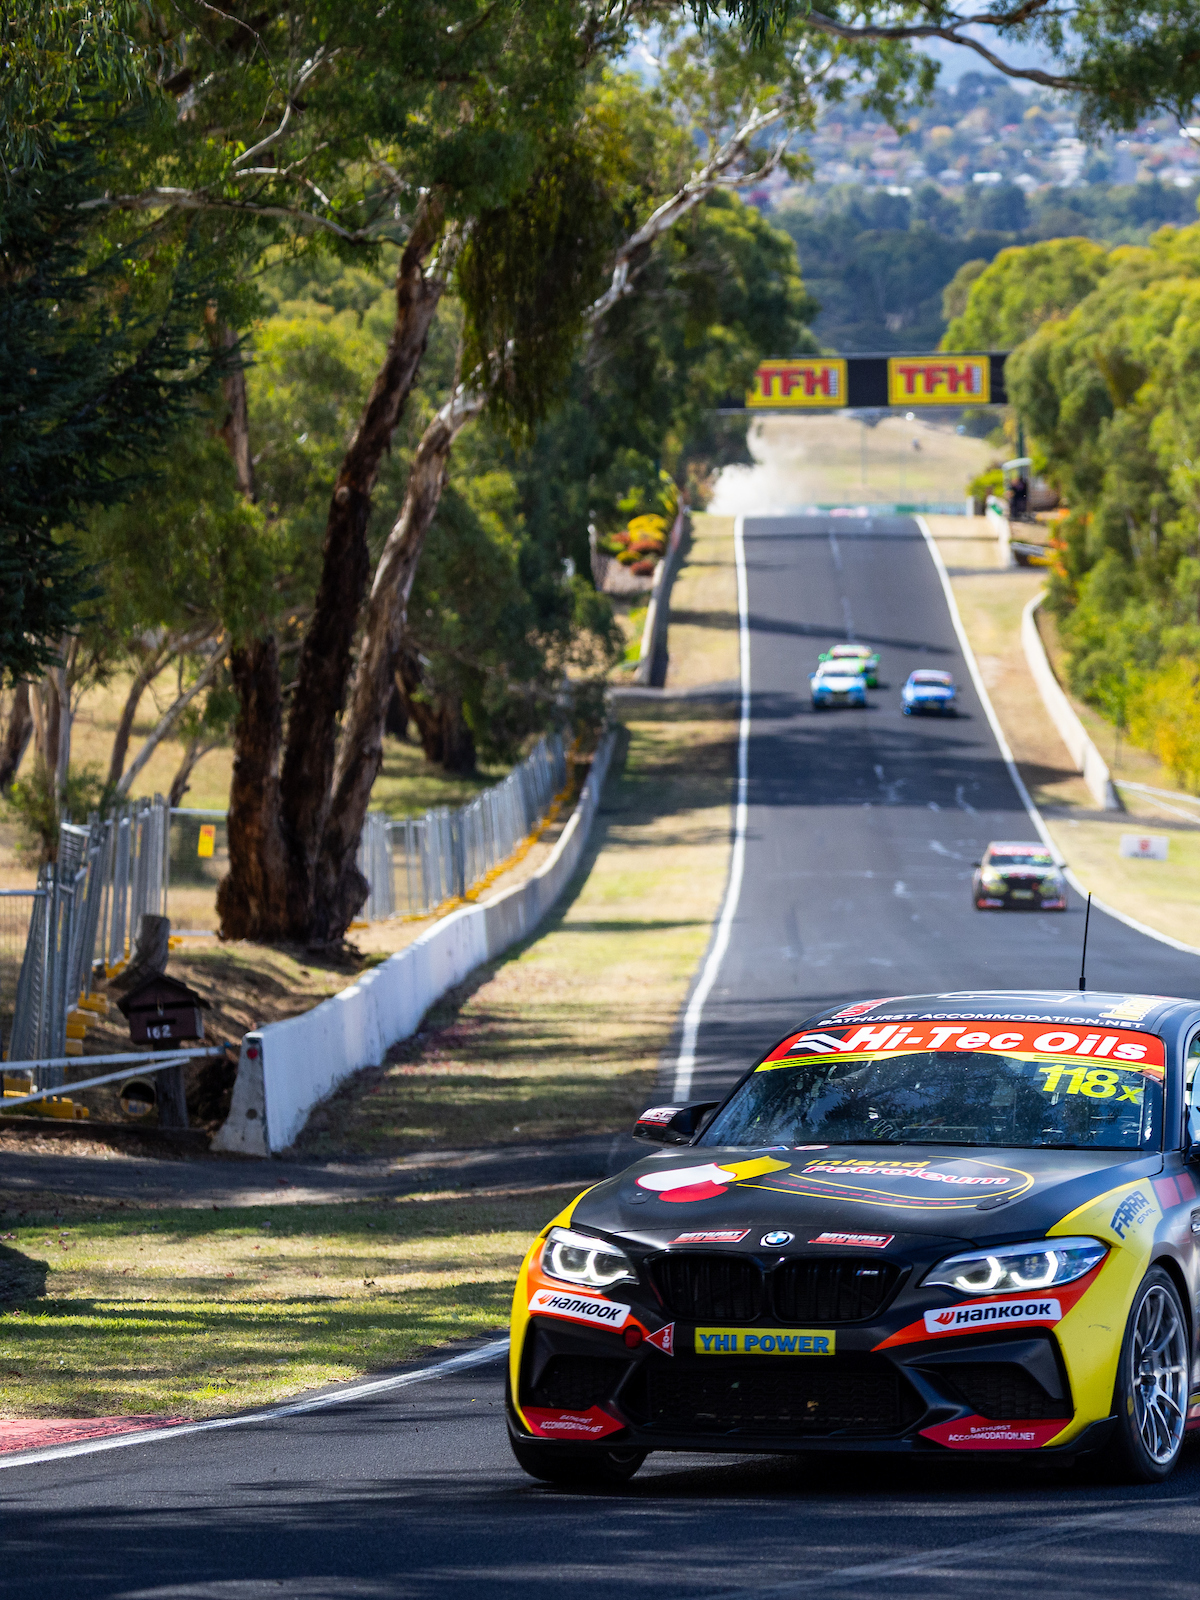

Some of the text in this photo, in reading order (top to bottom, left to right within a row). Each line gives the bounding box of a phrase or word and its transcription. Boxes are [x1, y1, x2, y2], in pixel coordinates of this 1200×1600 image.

[755, 366, 830, 397] TFH
[898, 364, 974, 394] TFH
[817, 1012, 1145, 1029] BATHURST ACCOMMODATION.NET
[146, 1024, 172, 1039] 162
[846, 1025, 1148, 1060] Hi-Tec Oils
[801, 1165, 1010, 1185] Petroleum
[1136, 1207, 1157, 1225] CIVIL
[661, 1328, 670, 1349] TOW
[699, 1334, 830, 1354] YHI POWER
[948, 1431, 1035, 1442] ACCOMMODATION.NET
